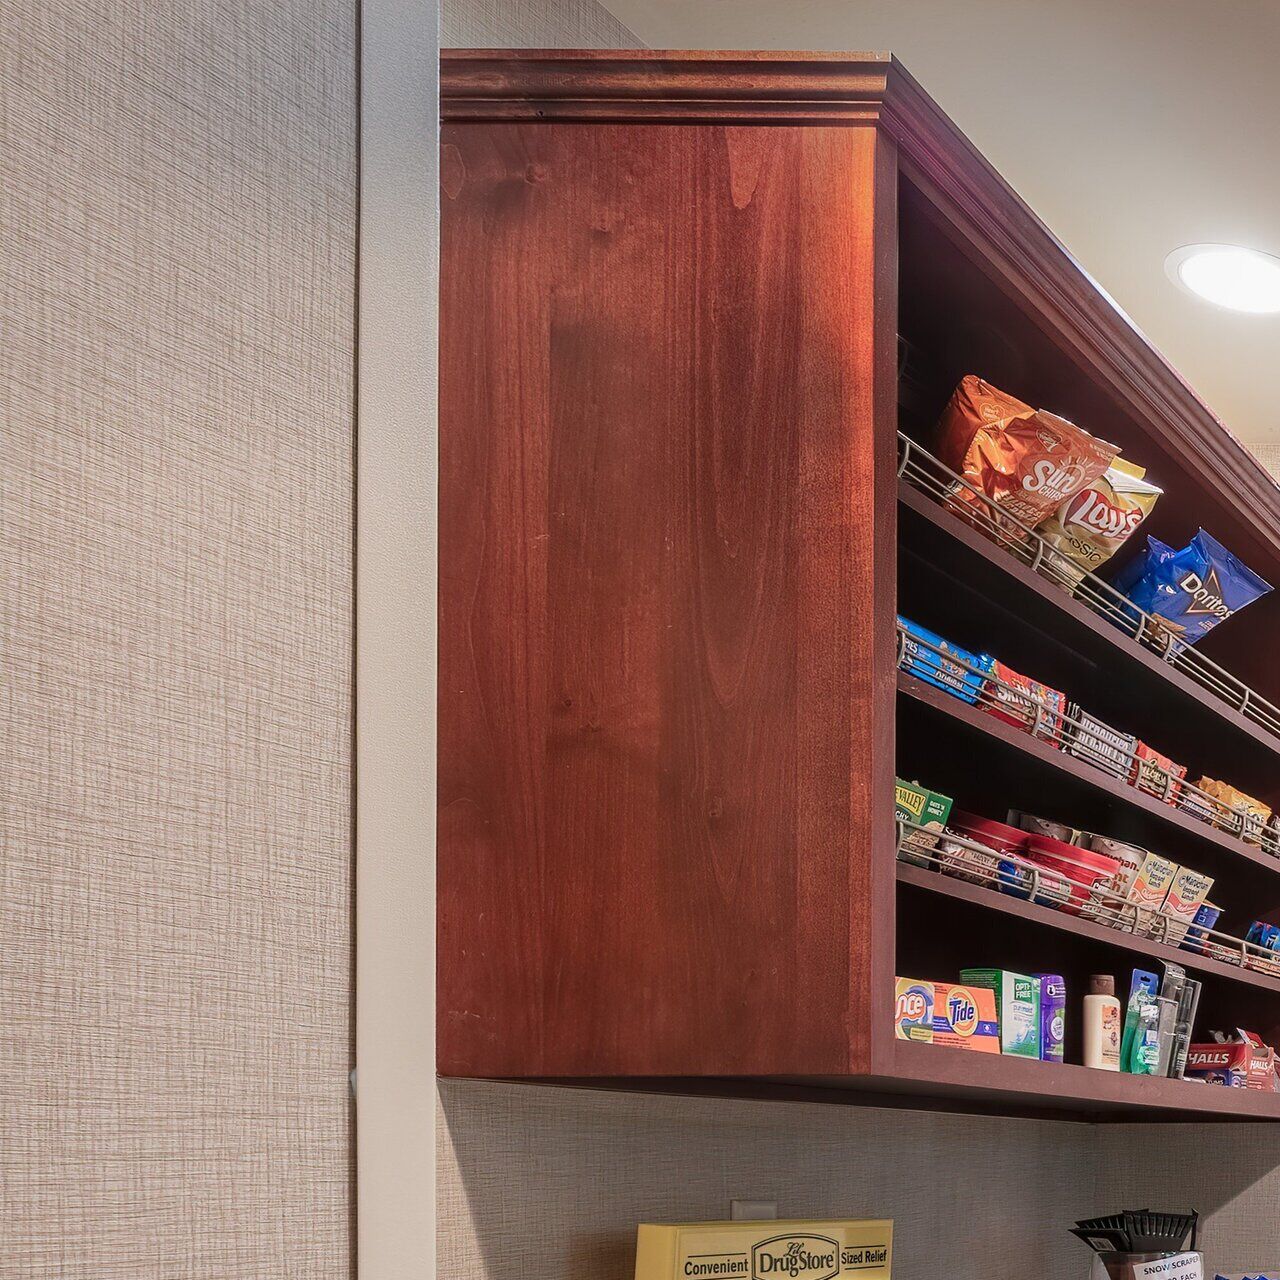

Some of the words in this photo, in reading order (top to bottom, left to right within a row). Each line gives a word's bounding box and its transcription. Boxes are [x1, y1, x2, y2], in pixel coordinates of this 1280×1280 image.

[1069, 489, 1143, 537] Lay's
[1180, 572, 1235, 621] Doritos
[900, 789, 926, 814] VALLEY
[927, 807, 944, 817] HONEY
[1015, 990, 1031, 999] FREE
[949, 998, 975, 1026] Tide
[1187, 1053, 1230, 1065] HALLS
[1250, 1060, 1268, 1070] HALLS
[684, 1259, 748, 1276] Convenient
[841, 1252, 863, 1264] Sized
[865, 1249, 888, 1264] Relief
[1143, 1263, 1170, 1275] SNOW
[1171, 1256, 1198, 1269] SCRAPER
